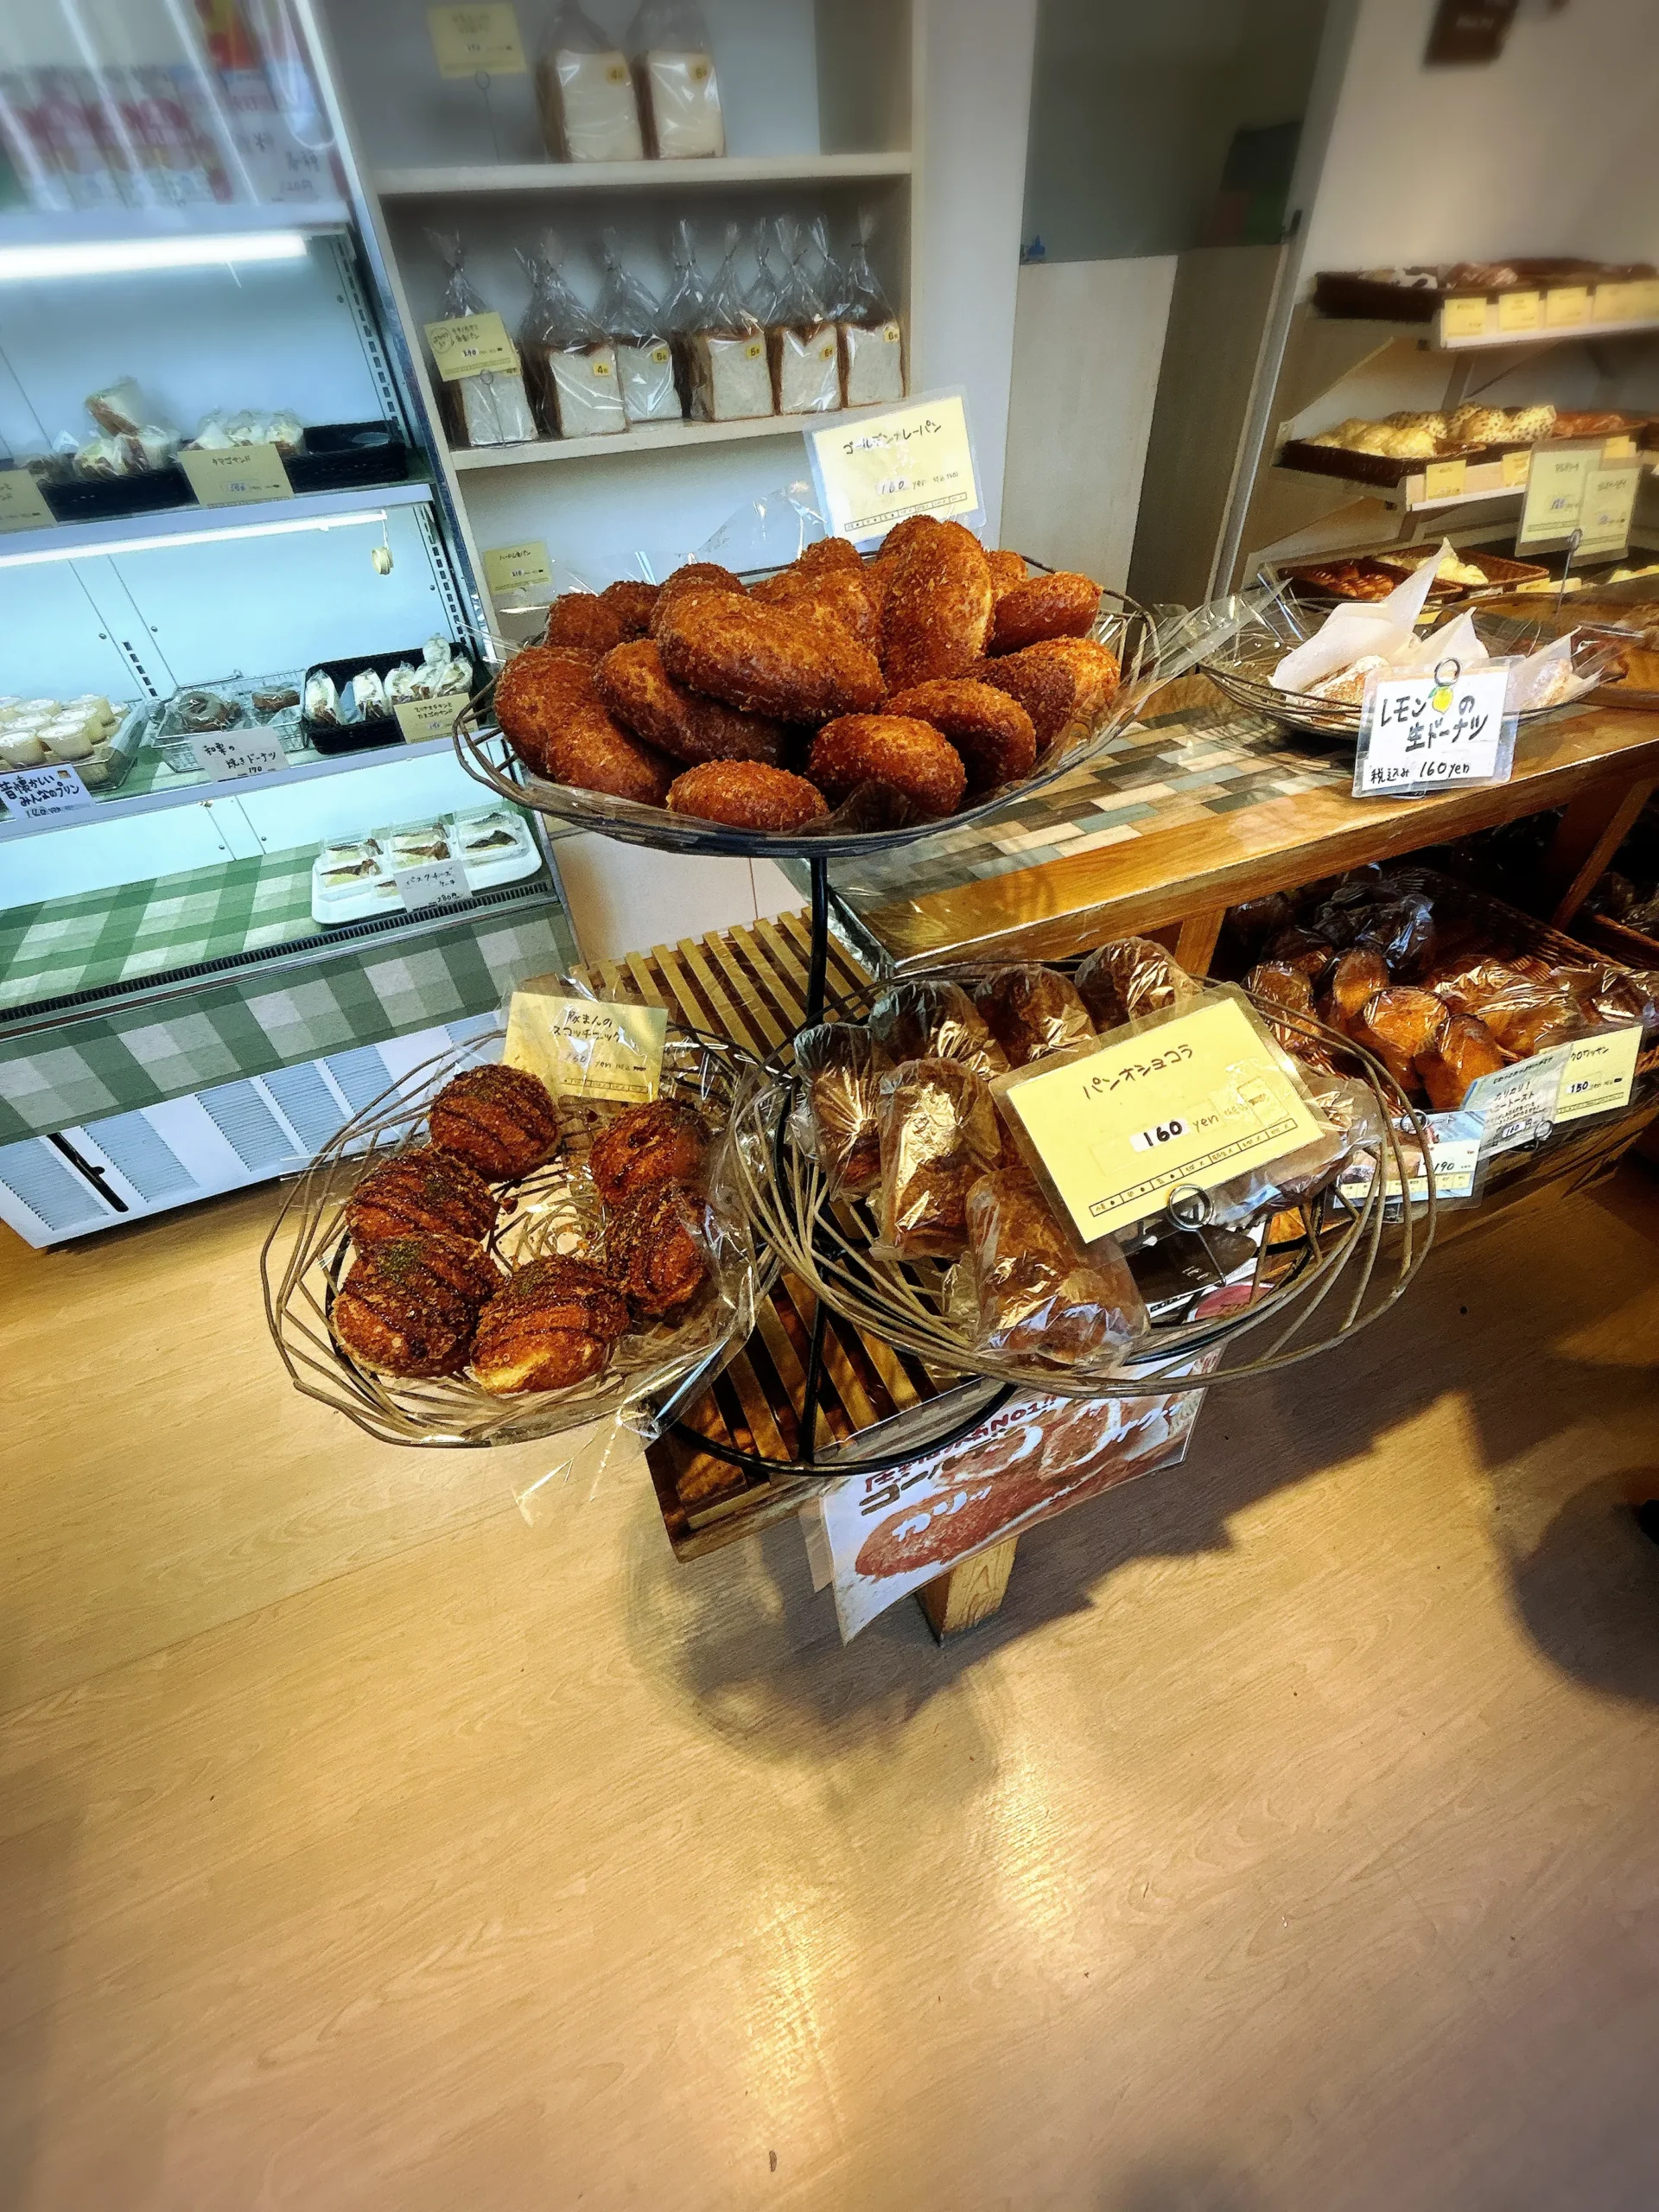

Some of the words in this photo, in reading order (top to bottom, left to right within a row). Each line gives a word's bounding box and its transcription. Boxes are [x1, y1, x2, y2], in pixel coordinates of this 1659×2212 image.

[1405, 715, 1489, 752] 生ドーナツ
[226, 752, 276, 769] 焼きドーナツ
[1370, 768, 1410, 784] 税込み
[0, 775, 55, 800] 昔懐かしい
[19, 781, 79, 807] みんなのプリン
[567, 1010, 613, 1027] 豚まんの
[1083, 1044, 1193, 1099] パンオショコラ
[1571, 1081, 1589, 1094] 150
[1142, 1121, 1183, 1147] 160
[1192, 1115, 1219, 1133] yen
[1433, 1161, 1454, 1172] 190
